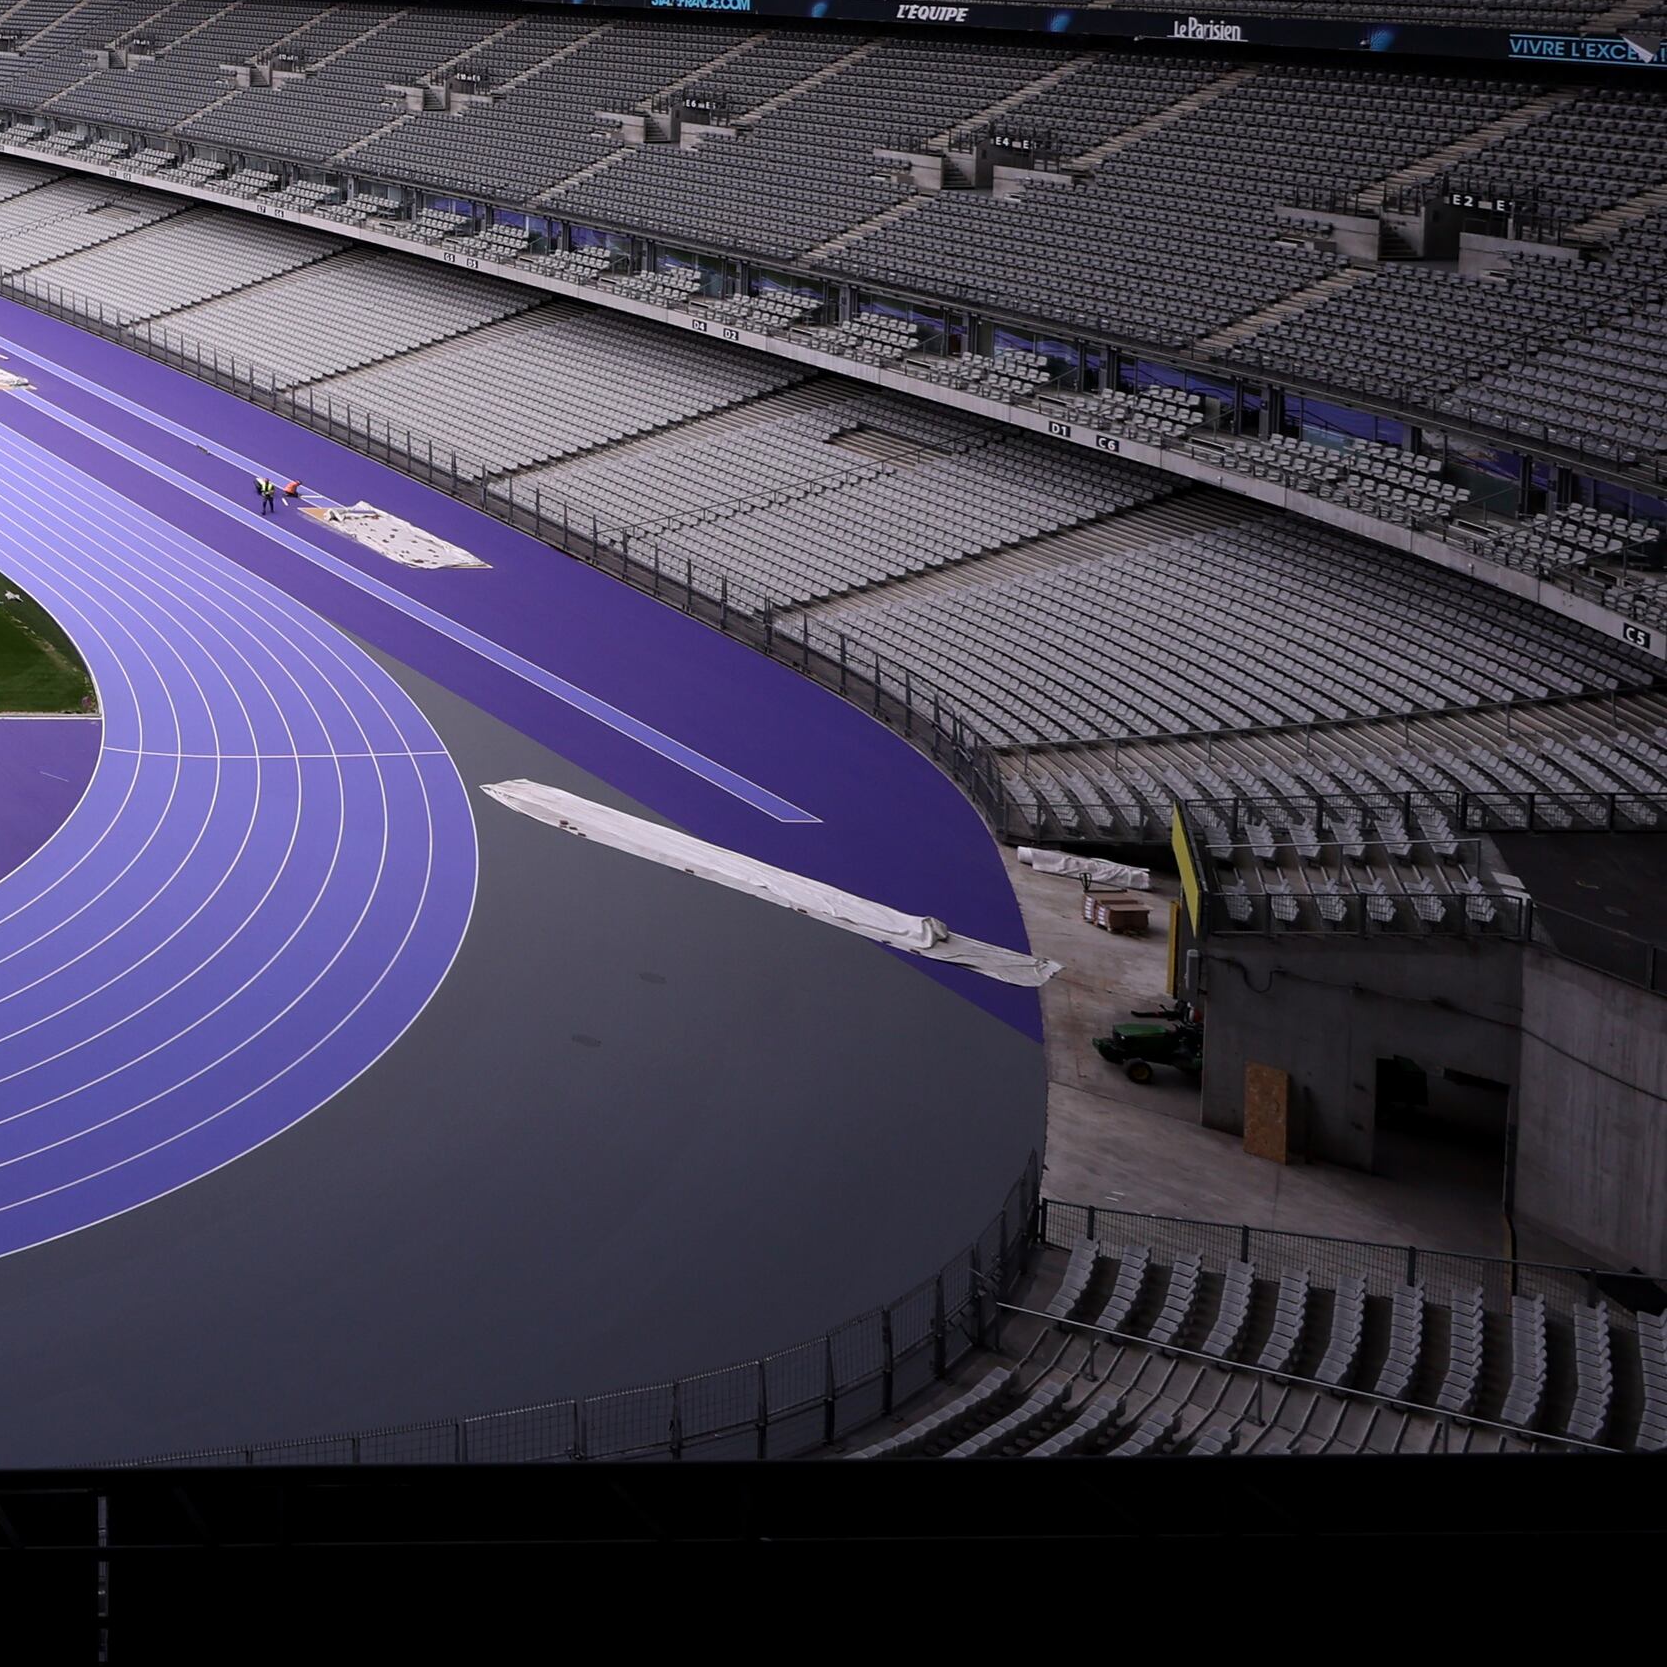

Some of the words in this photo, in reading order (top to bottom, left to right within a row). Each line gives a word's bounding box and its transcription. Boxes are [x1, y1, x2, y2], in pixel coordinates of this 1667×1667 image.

[1509, 38, 1566, 57] VIVRE
[995, 136, 1010, 147] E4
[1452, 193, 1474, 208] E2
[694, 320, 707, 331] D4
[725, 329, 738, 340] D2
[1051, 423, 1068, 437] D1
[1098, 437, 1116, 451] C6
[1625, 626, 1645, 645] C5
